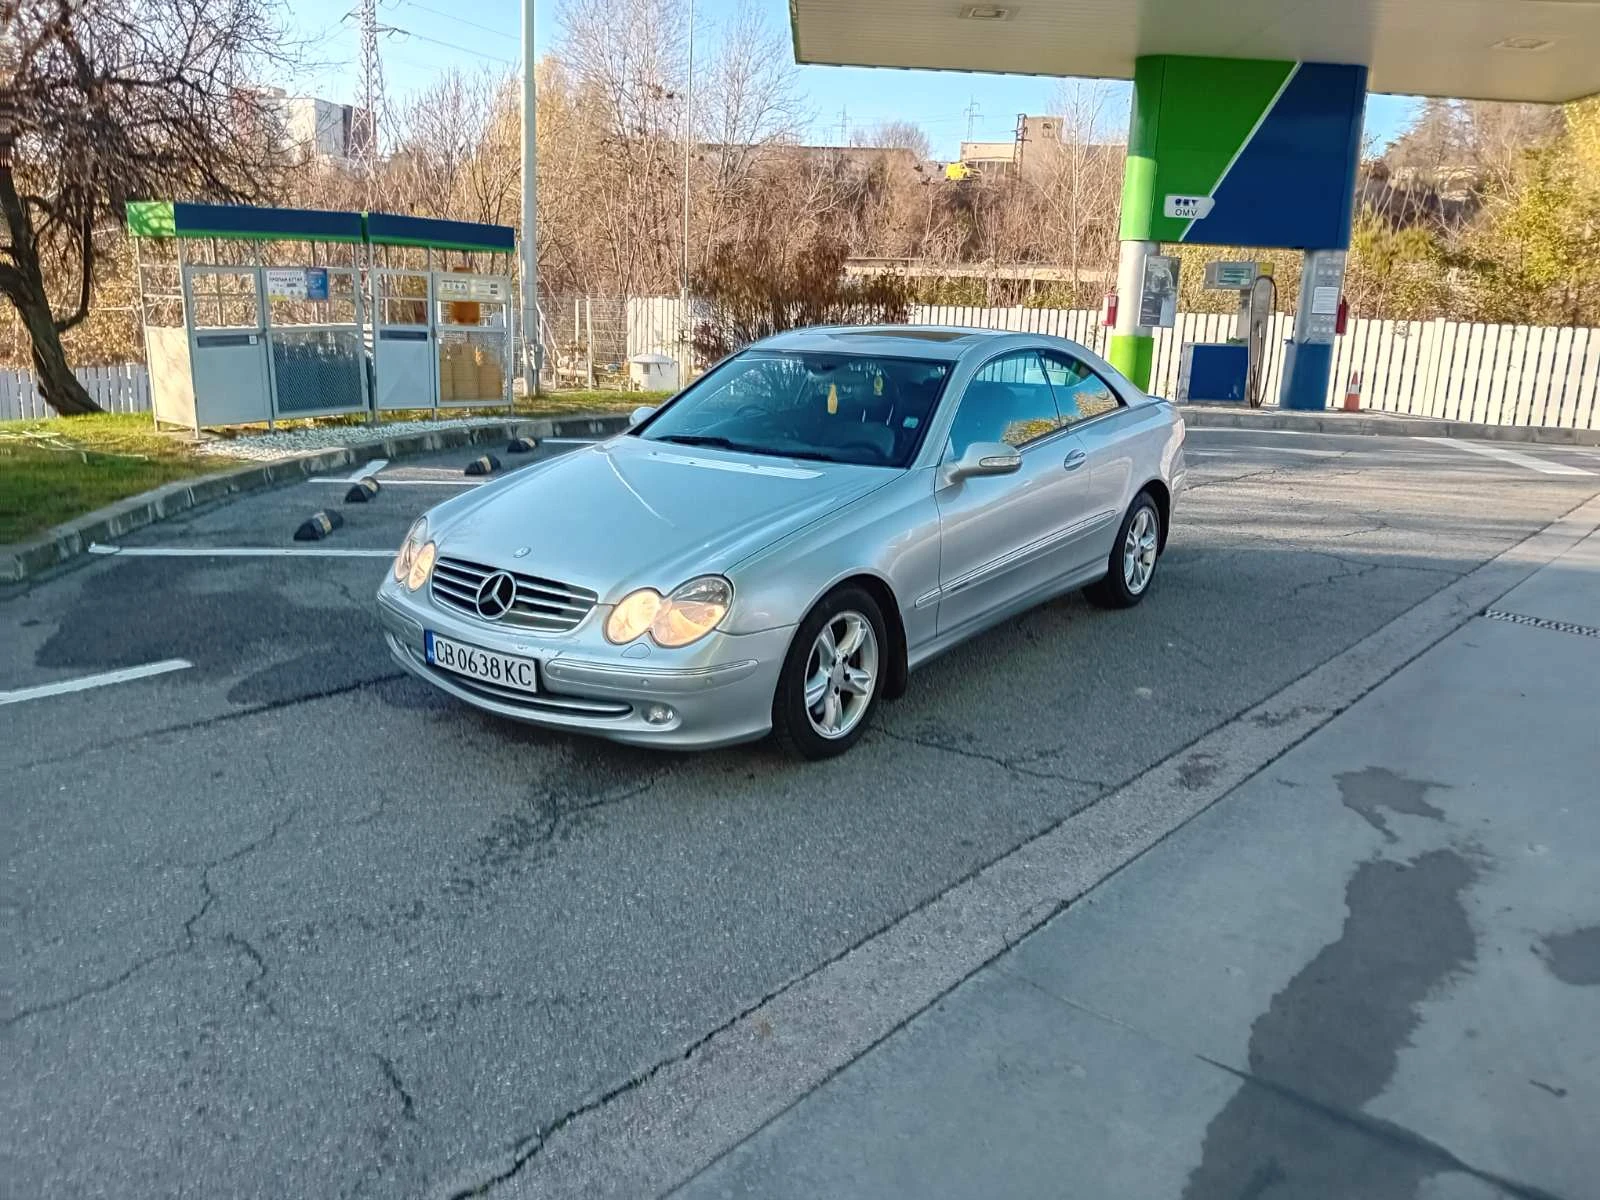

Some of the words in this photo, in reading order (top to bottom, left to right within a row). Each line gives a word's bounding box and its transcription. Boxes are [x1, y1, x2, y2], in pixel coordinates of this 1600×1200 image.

[1175, 208, 1198, 216] OMV
[435, 640, 455, 666] CB
[457, 648, 501, 679] 0638
[504, 659, 531, 686] KC
